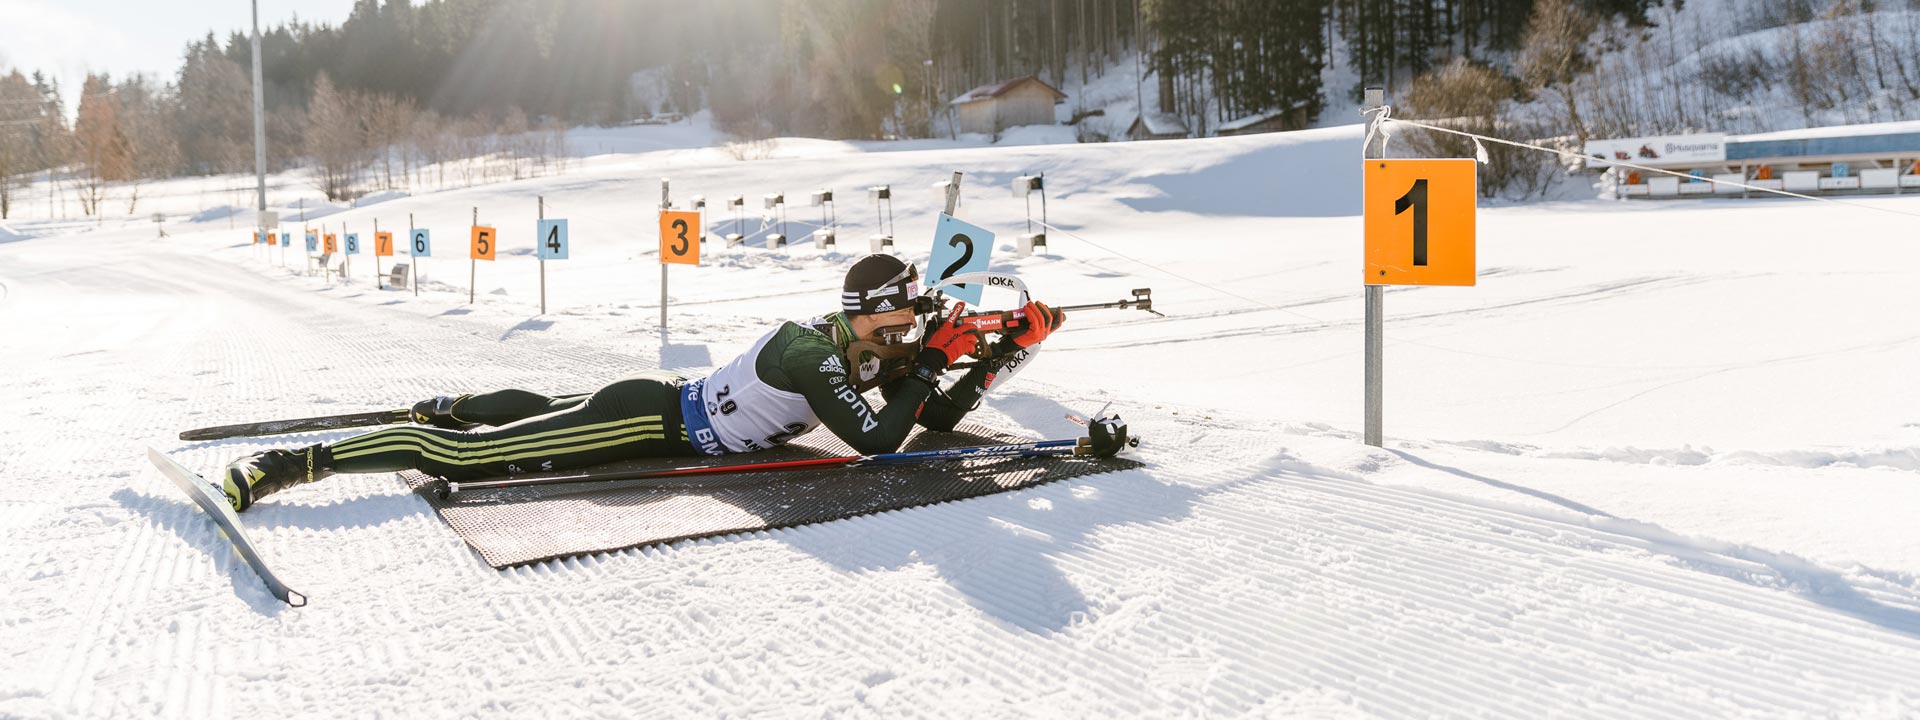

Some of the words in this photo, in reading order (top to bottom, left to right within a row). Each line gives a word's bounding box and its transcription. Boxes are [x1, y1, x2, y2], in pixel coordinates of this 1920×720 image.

[1672, 143, 1719, 153] Husqvarna
[1395, 179, 1428, 266] 1
[326, 236, 334, 250] 9
[347, 235, 356, 251] 8
[378, 236, 388, 253] 7
[415, 233, 425, 253] 6
[477, 231, 489, 255] 5
[547, 225, 561, 254] 4
[670, 218, 689, 256] 3
[940, 233, 974, 289] 2
[874, 305, 896, 313] adidas
[1005, 349, 1030, 373] JOKA
[716, 384, 738, 416] 29
[833, 384, 879, 433] Audi
